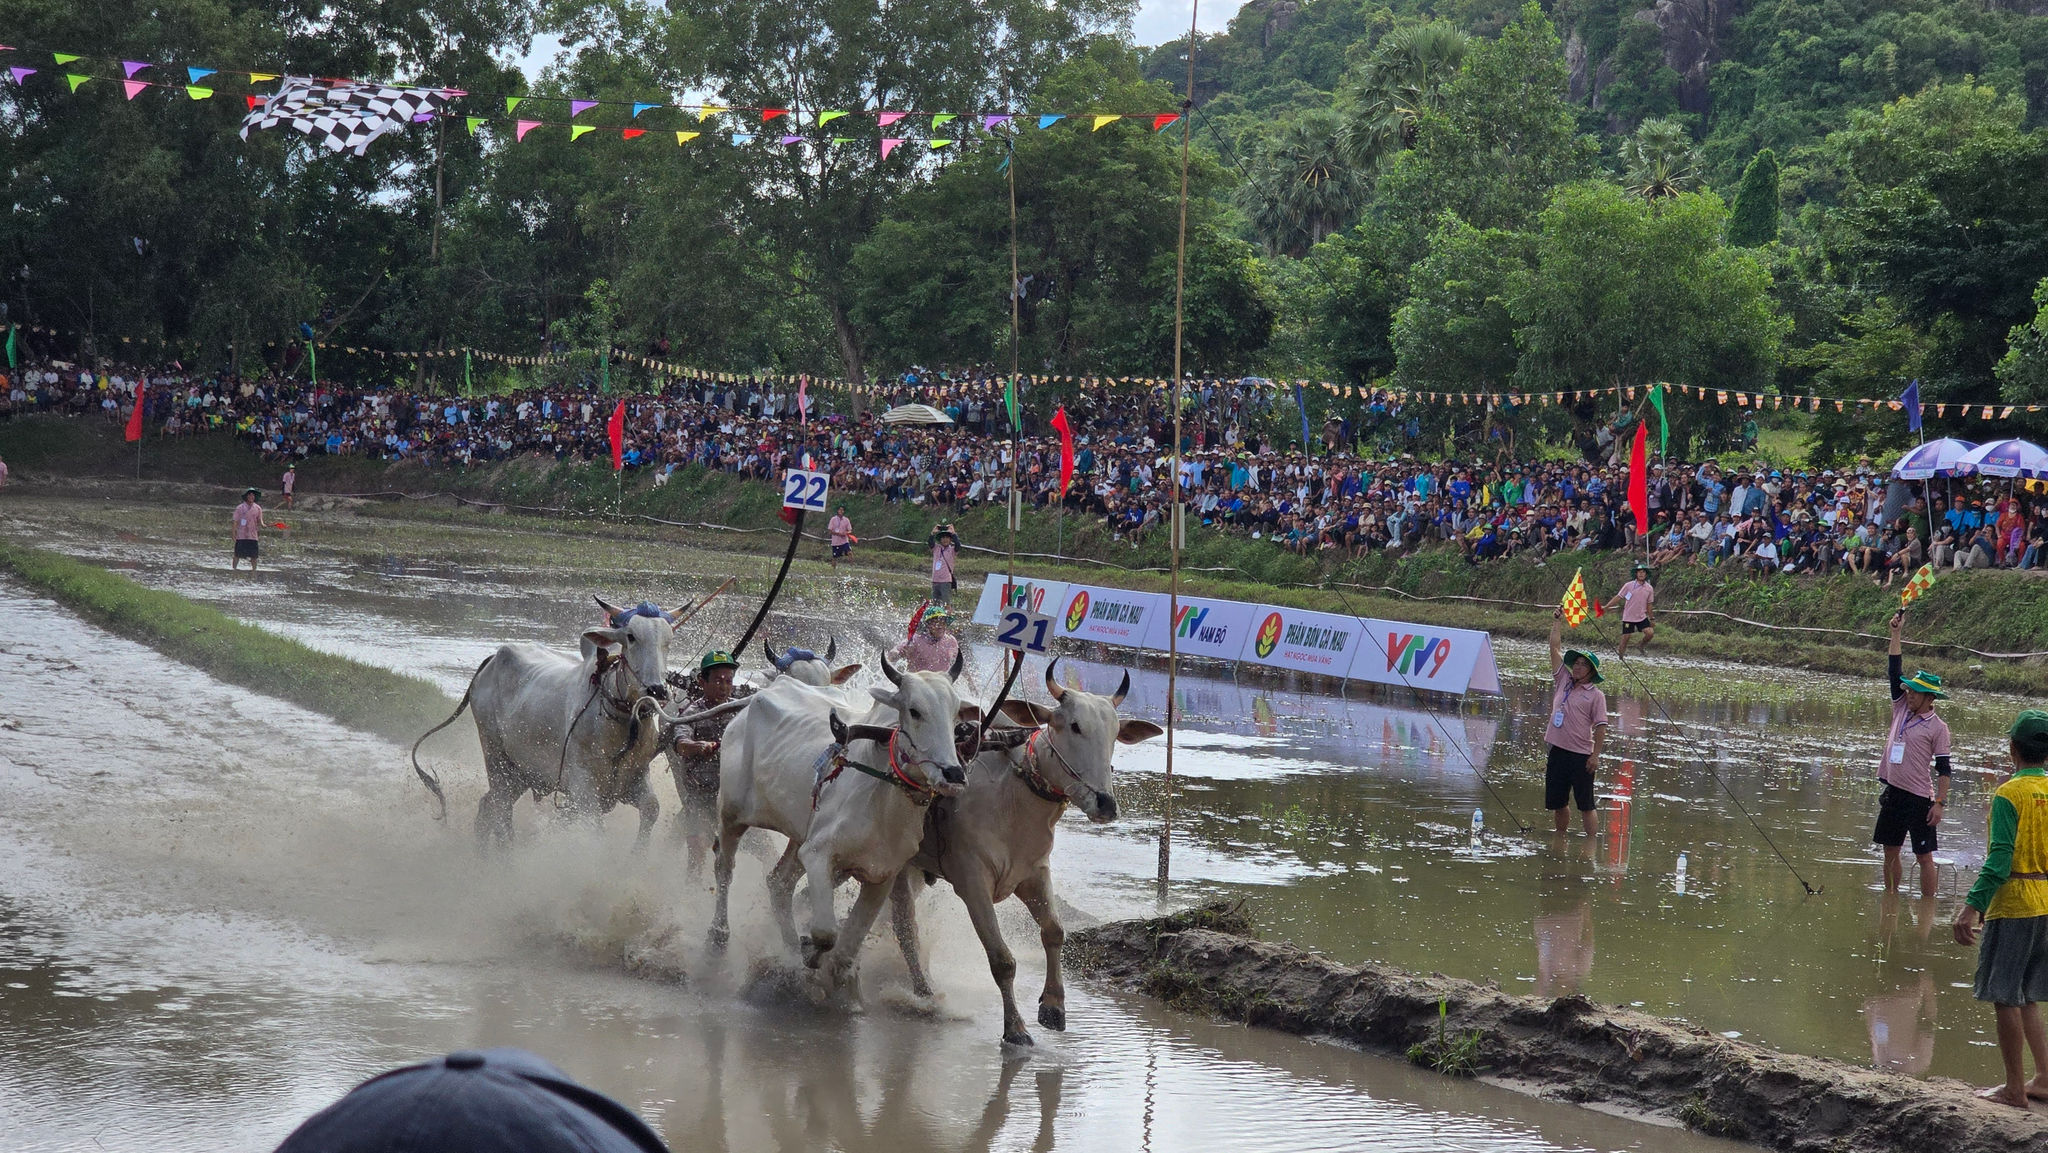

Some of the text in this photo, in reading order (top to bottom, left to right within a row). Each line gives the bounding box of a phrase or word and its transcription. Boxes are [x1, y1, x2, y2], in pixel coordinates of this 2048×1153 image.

[786, 474, 827, 507] 22
[1126, 605, 1145, 625] MAU
[997, 612, 1048, 652] 21
[1198, 625, 1228, 647] NAM BỘ
[1284, 621, 1349, 653] PHÂN BÓN CÀ MAU
[1387, 632, 1451, 679] VTV9
